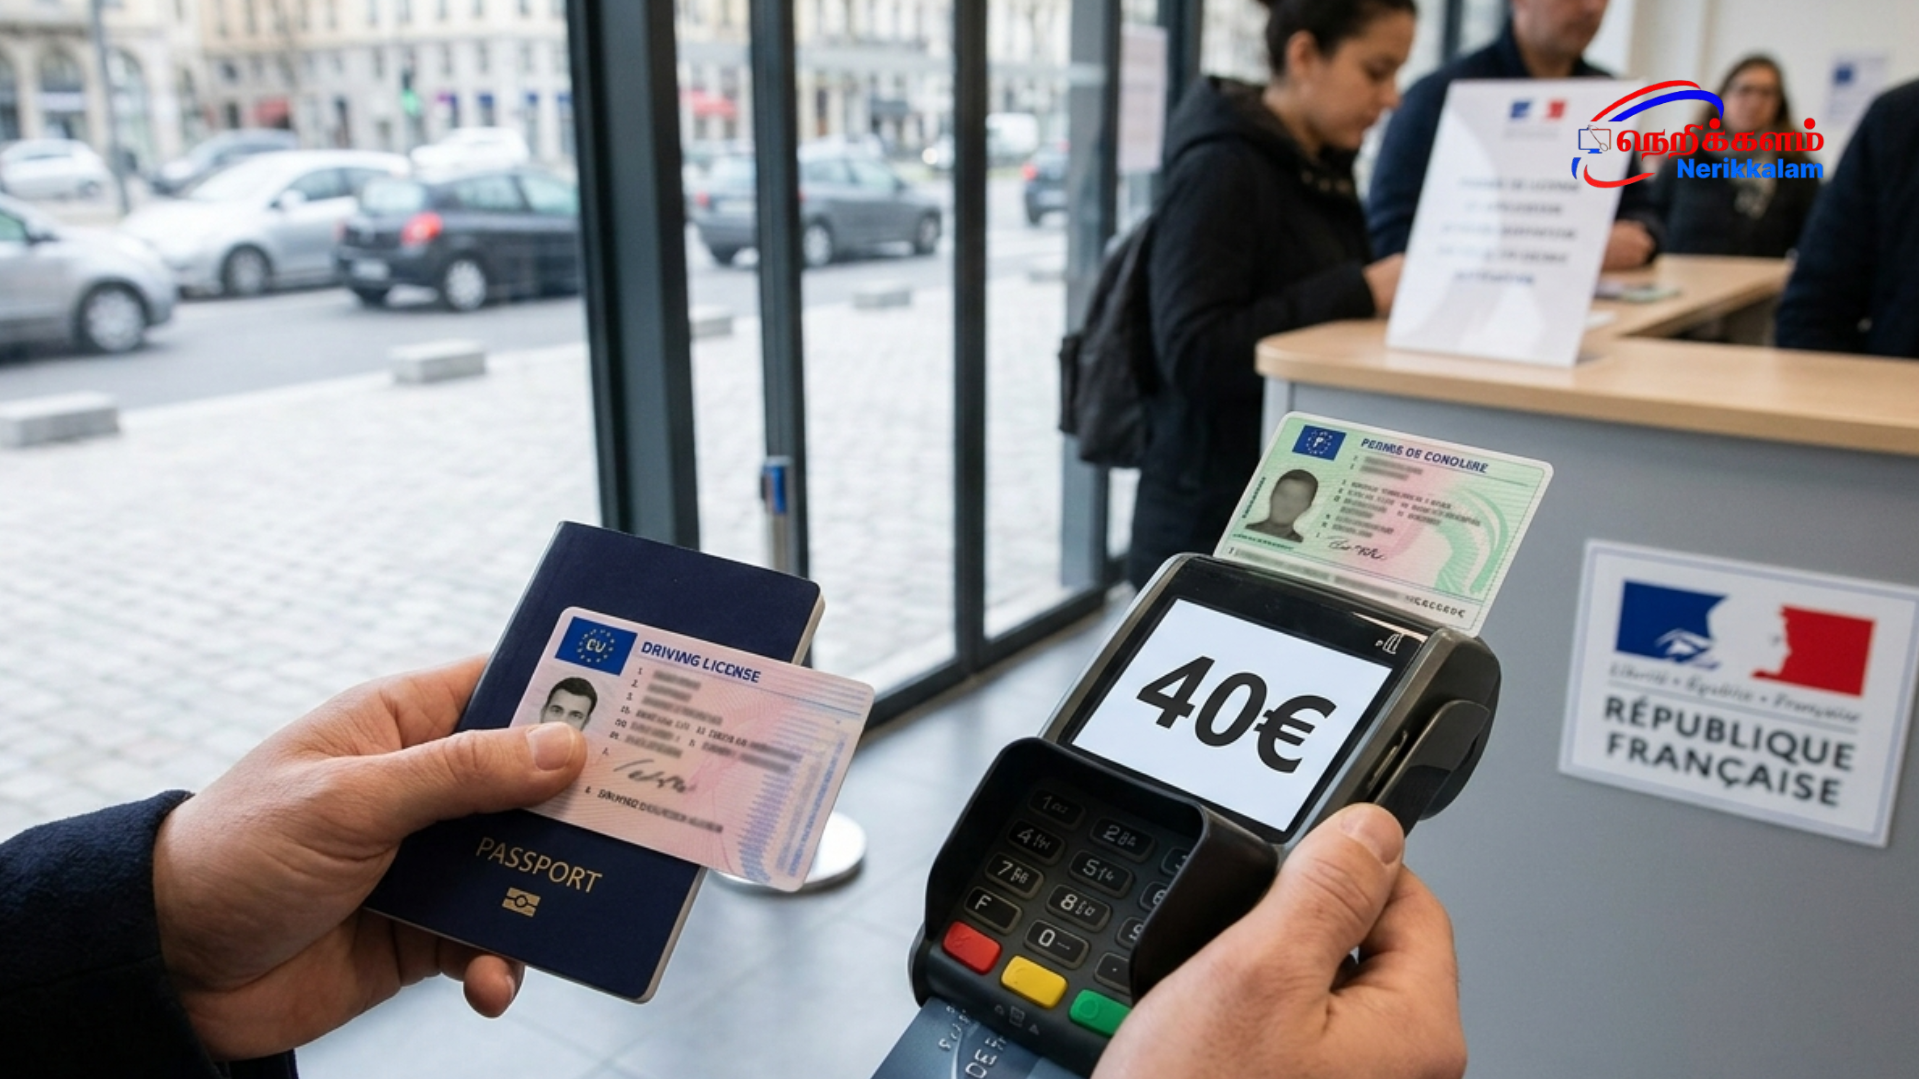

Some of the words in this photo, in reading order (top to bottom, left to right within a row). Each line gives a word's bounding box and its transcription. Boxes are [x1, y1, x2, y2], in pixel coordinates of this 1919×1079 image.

[641, 641, 702, 667] DRIVING
[702, 657, 761, 684] LICENSE
[1136, 656, 1337, 774] 40€
[1604, 691, 1856, 772] RÉPUBLIQUE
[1606, 733, 1842, 808] FRANÇAISE
[475, 837, 603, 893] PASSPORT
[974, 894, 992, 910] F
[1060, 893, 1078, 911] 8
